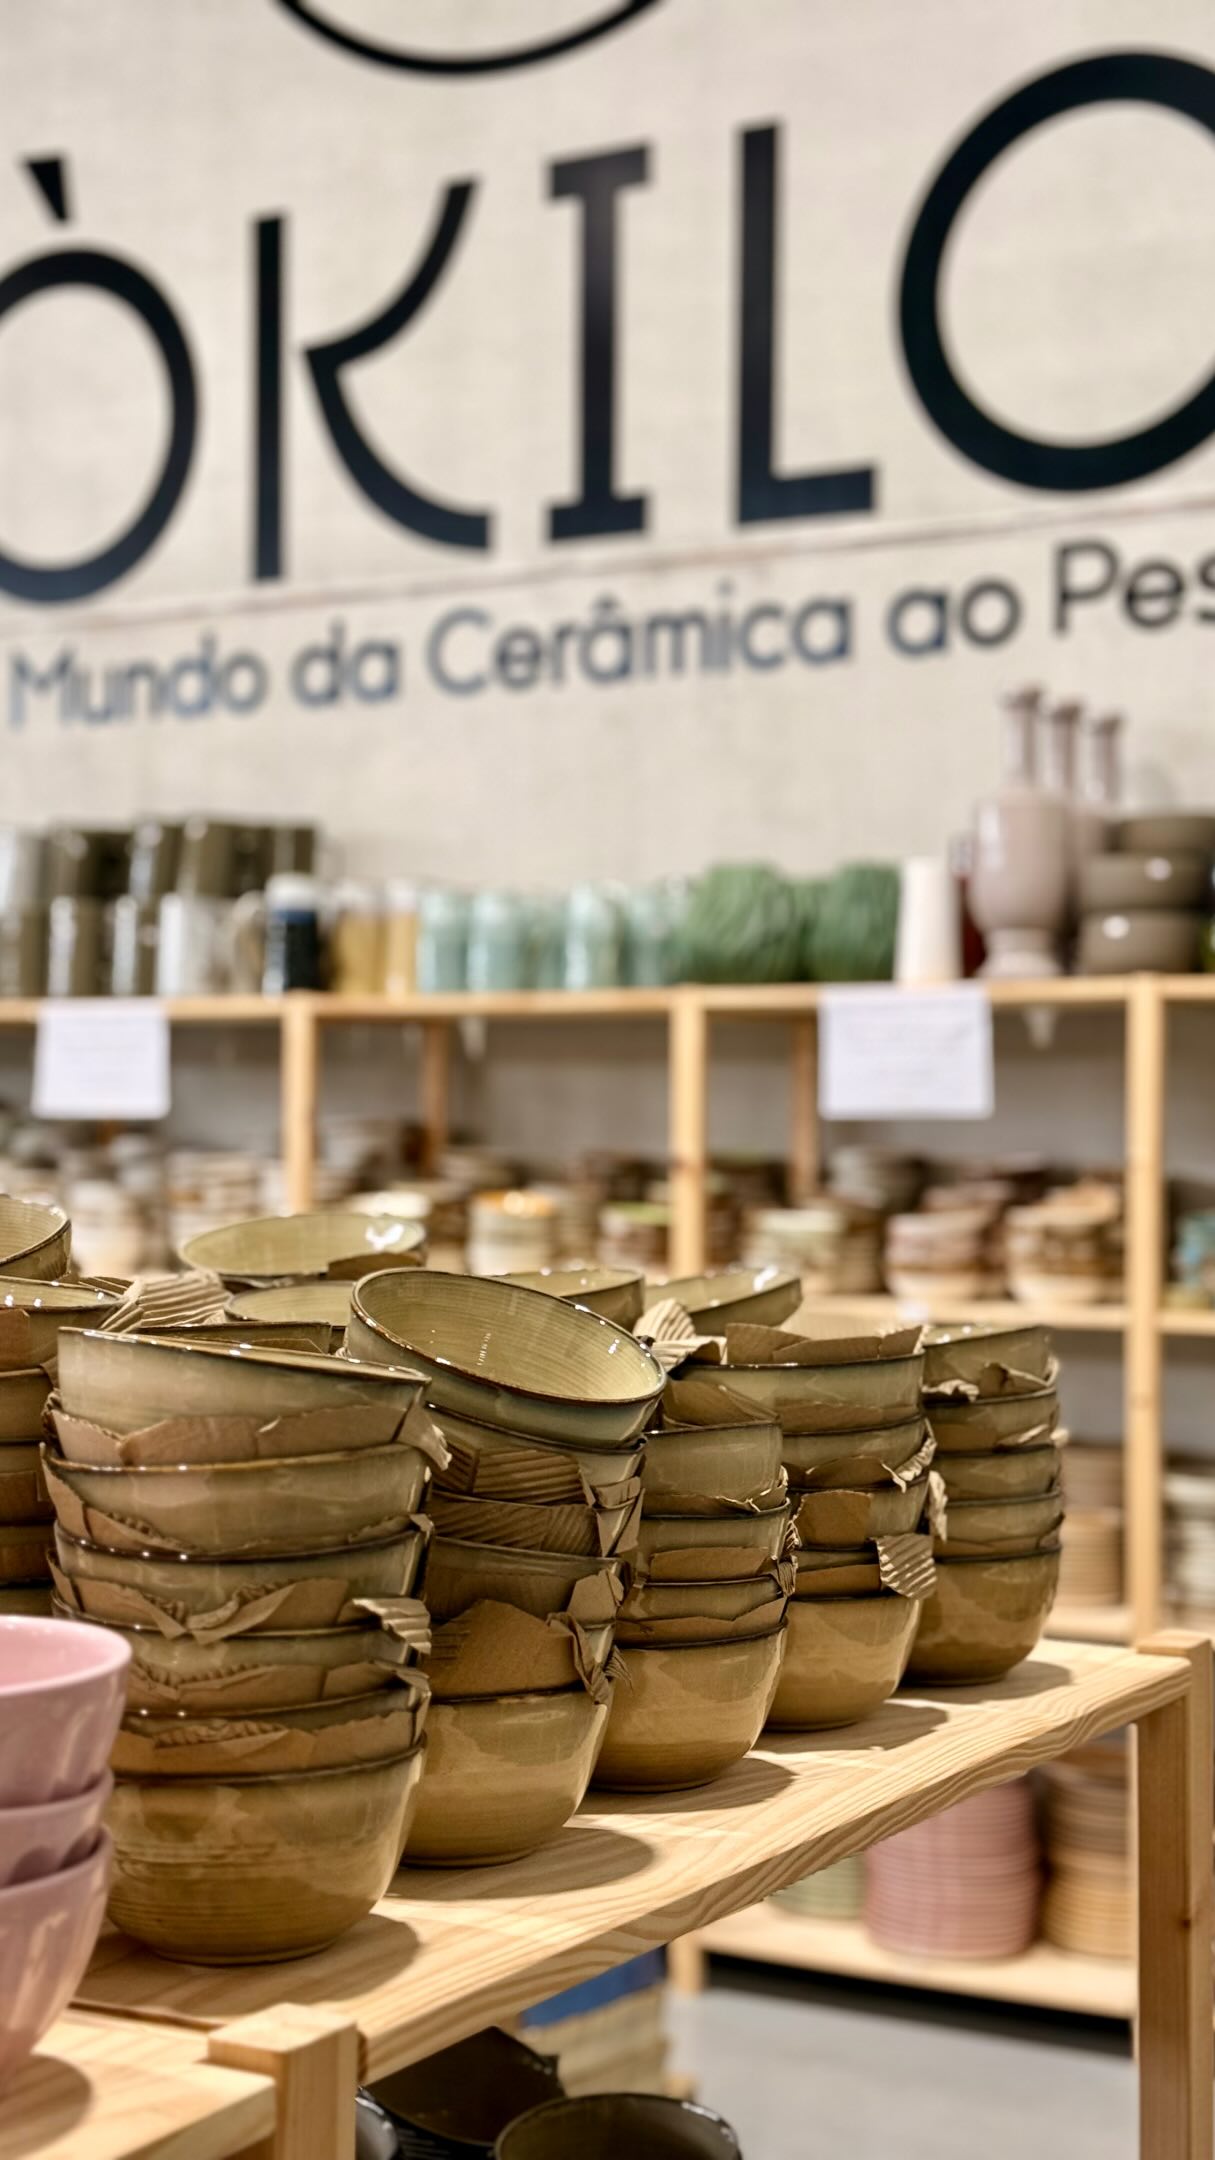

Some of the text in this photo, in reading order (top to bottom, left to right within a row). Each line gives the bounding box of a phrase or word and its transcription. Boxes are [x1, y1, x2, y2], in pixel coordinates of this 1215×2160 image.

[8, 632, 268, 728] Mundo
[293, 621, 399, 705] da
[427, 580, 854, 694] Cerâmica
[887, 577, 1022, 656] ao
